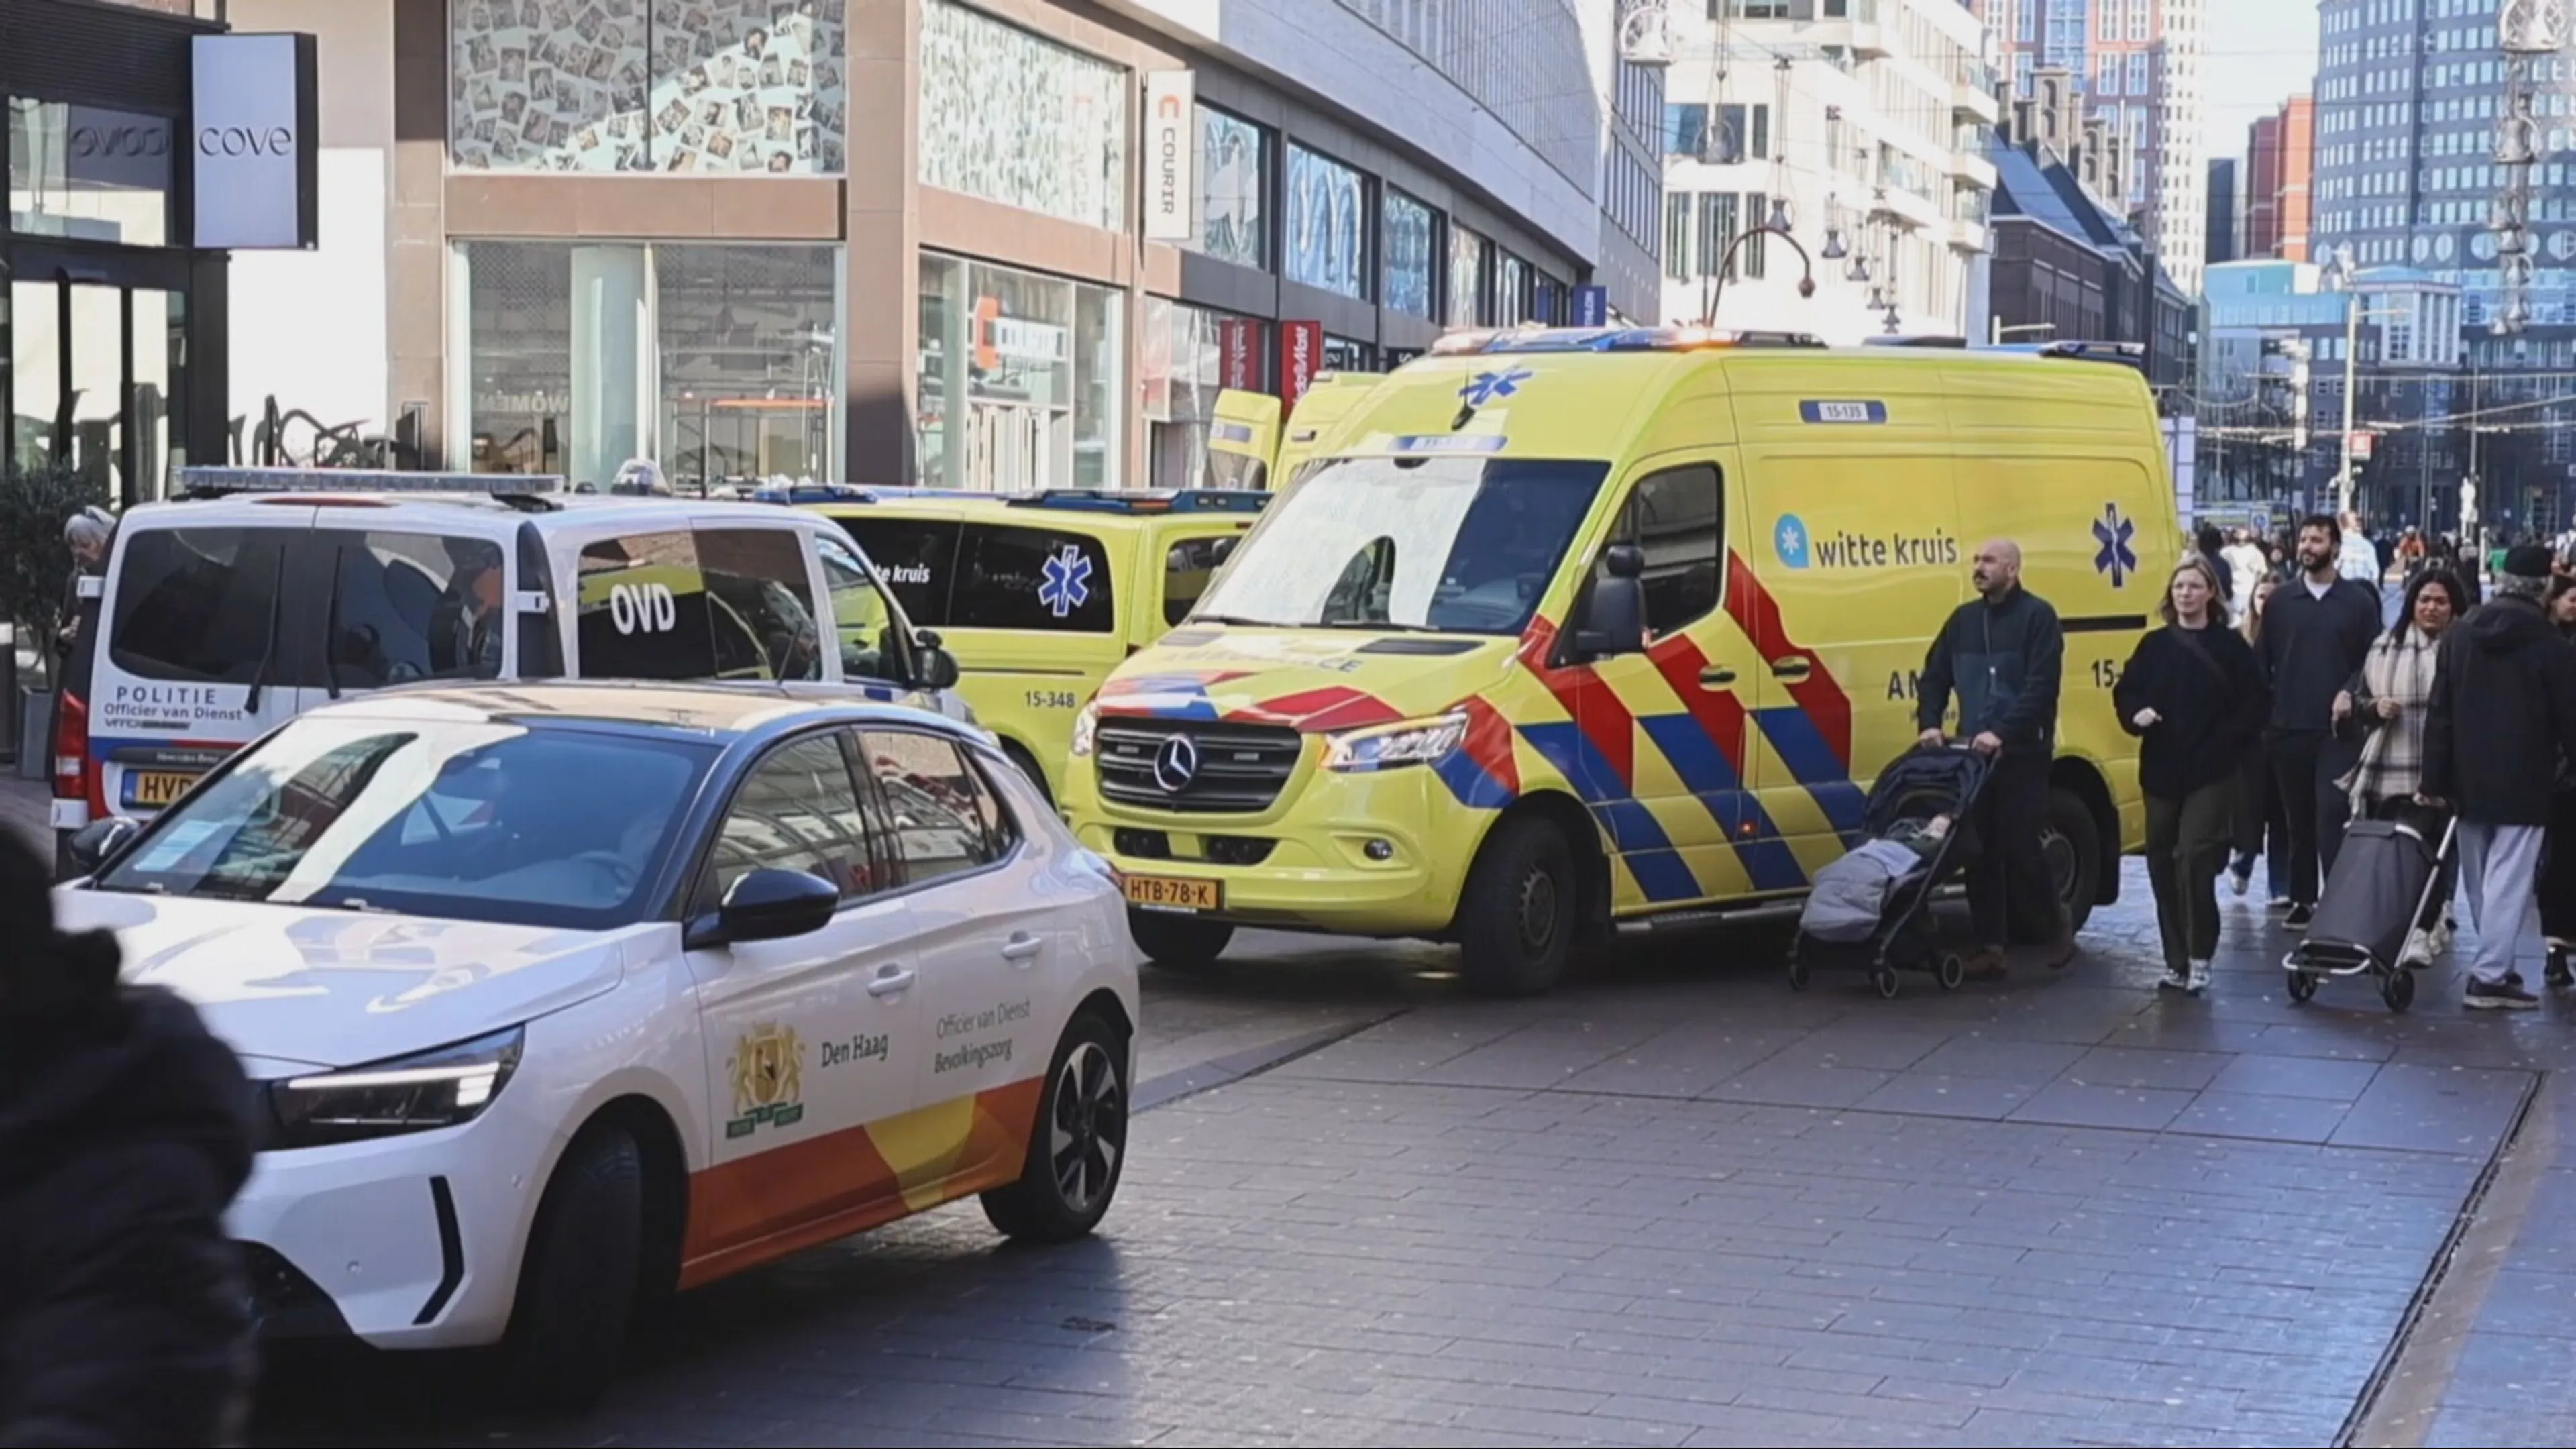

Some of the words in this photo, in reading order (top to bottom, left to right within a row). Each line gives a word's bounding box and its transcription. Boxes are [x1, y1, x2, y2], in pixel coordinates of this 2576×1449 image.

[199, 127, 292, 156] cove
[1161, 127, 1176, 215] COURIR
[1815, 530, 1886, 568] witte
[1894, 527, 1957, 565] kruis
[892, 563, 931, 584] kruis
[610, 583, 676, 635] OVD
[117, 686, 216, 704] POLITIE
[1025, 691, 1075, 708] 15-348
[104, 703, 158, 717] Officier
[162, 708, 189, 718] van
[194, 706, 242, 720] Dienst
[821, 1041, 849, 1068] Den
[853, 1034, 889, 1061] Haag
